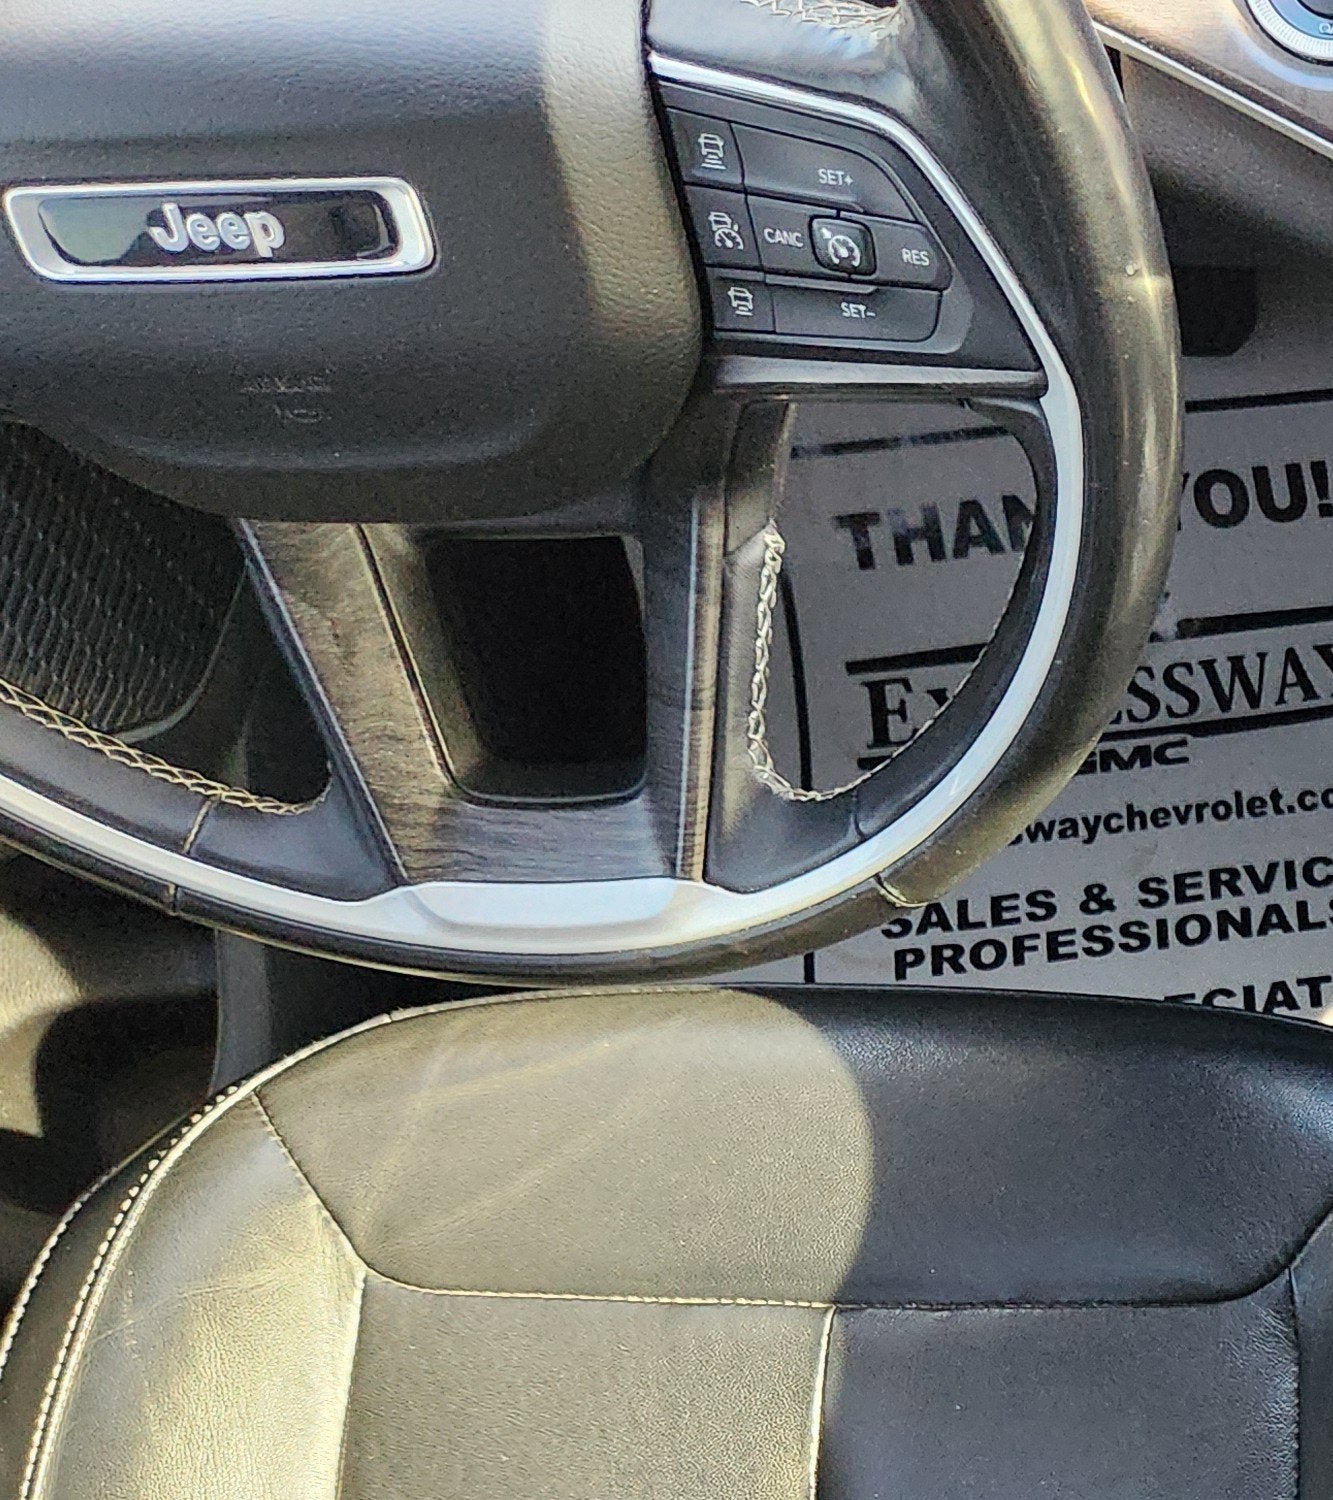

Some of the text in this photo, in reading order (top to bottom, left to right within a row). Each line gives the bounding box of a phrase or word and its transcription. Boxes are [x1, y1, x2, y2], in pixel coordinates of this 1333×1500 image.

[148, 202, 286, 258] Jeep
[763, 227, 804, 248] CANC
[901, 248, 930, 266] RES
[833, 493, 1037, 571] THAN
[881, 889, 1058, 940] SALES
[1078, 883, 1118, 917] &
